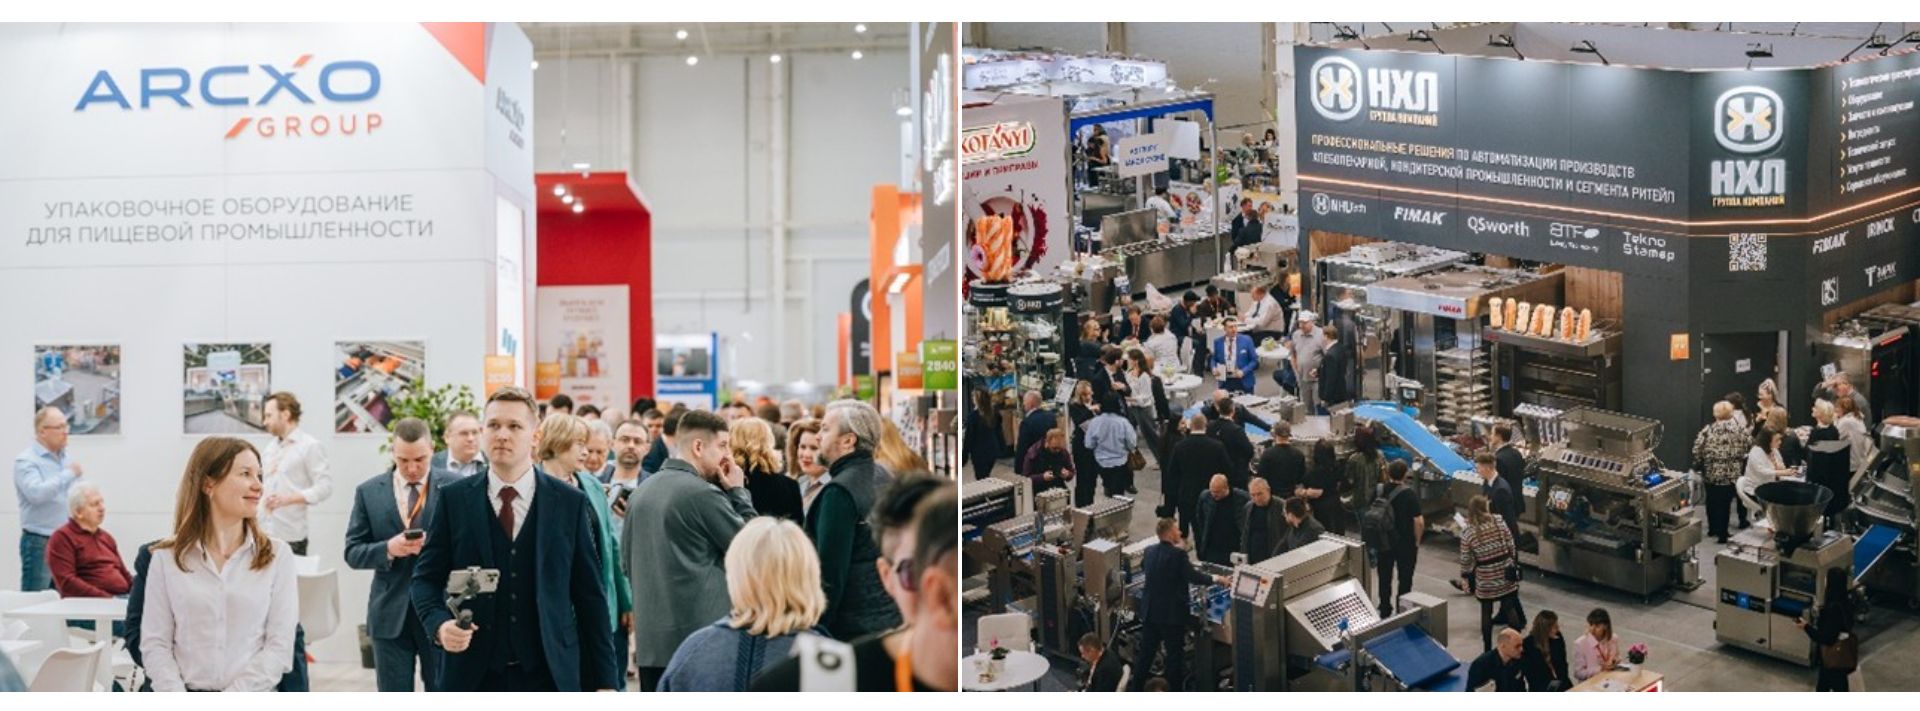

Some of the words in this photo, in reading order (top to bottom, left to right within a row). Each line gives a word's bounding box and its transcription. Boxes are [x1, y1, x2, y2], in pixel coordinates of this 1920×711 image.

[74, 54, 381, 112] ARCXO
[1367, 68, 1439, 112] НХЛ
[256, 113, 383, 139] GROUP
[1311, 134, 1406, 154] ПРОФЕССИОНАЛЬНЫЕ
[1409, 144, 1454, 159] РЕШЕНИЯ
[1457, 149, 1469, 161] ПО
[1472, 151, 1557, 171] АВТОМАТИЗАЦИИ
[1559, 159, 1636, 179] ПРОИЗВОДСТВ
[1312, 152, 1389, 172] ХЛЕБОПЕКАРНОЙ,
[1391, 161, 1463, 180] КОНДИТЕРСКОЙ
[1466, 168, 1563, 191] ПРОМЫШЛЕННОСТИ
[1565, 179, 1574, 192] И
[1576, 180, 1629, 198] СЕГМЕНТА
[1631, 186, 1676, 204] РИТЕЙЛ
[1711, 159, 1786, 195] НХЛ
[44, 198, 216, 219] УПАКОВОЧНОЕ
[222, 194, 414, 216] ОБОРУДОВАНИЕ
[1712, 196, 1740, 207] ГРУППА
[1742, 194, 1785, 206] КОМПАНИЙ
[1393, 206, 1448, 225] FIMAK
[1466, 215, 1531, 238] QSworth
[26, 226, 72, 247] ДЛЯ
[78, 221, 194, 245] ПИЩЕВОЙ
[200, 219, 434, 241] ПРОМЫШЛЕННОСТИ
[1622, 231, 1667, 248] Tekno
[926, 360, 956, 373] 2840
